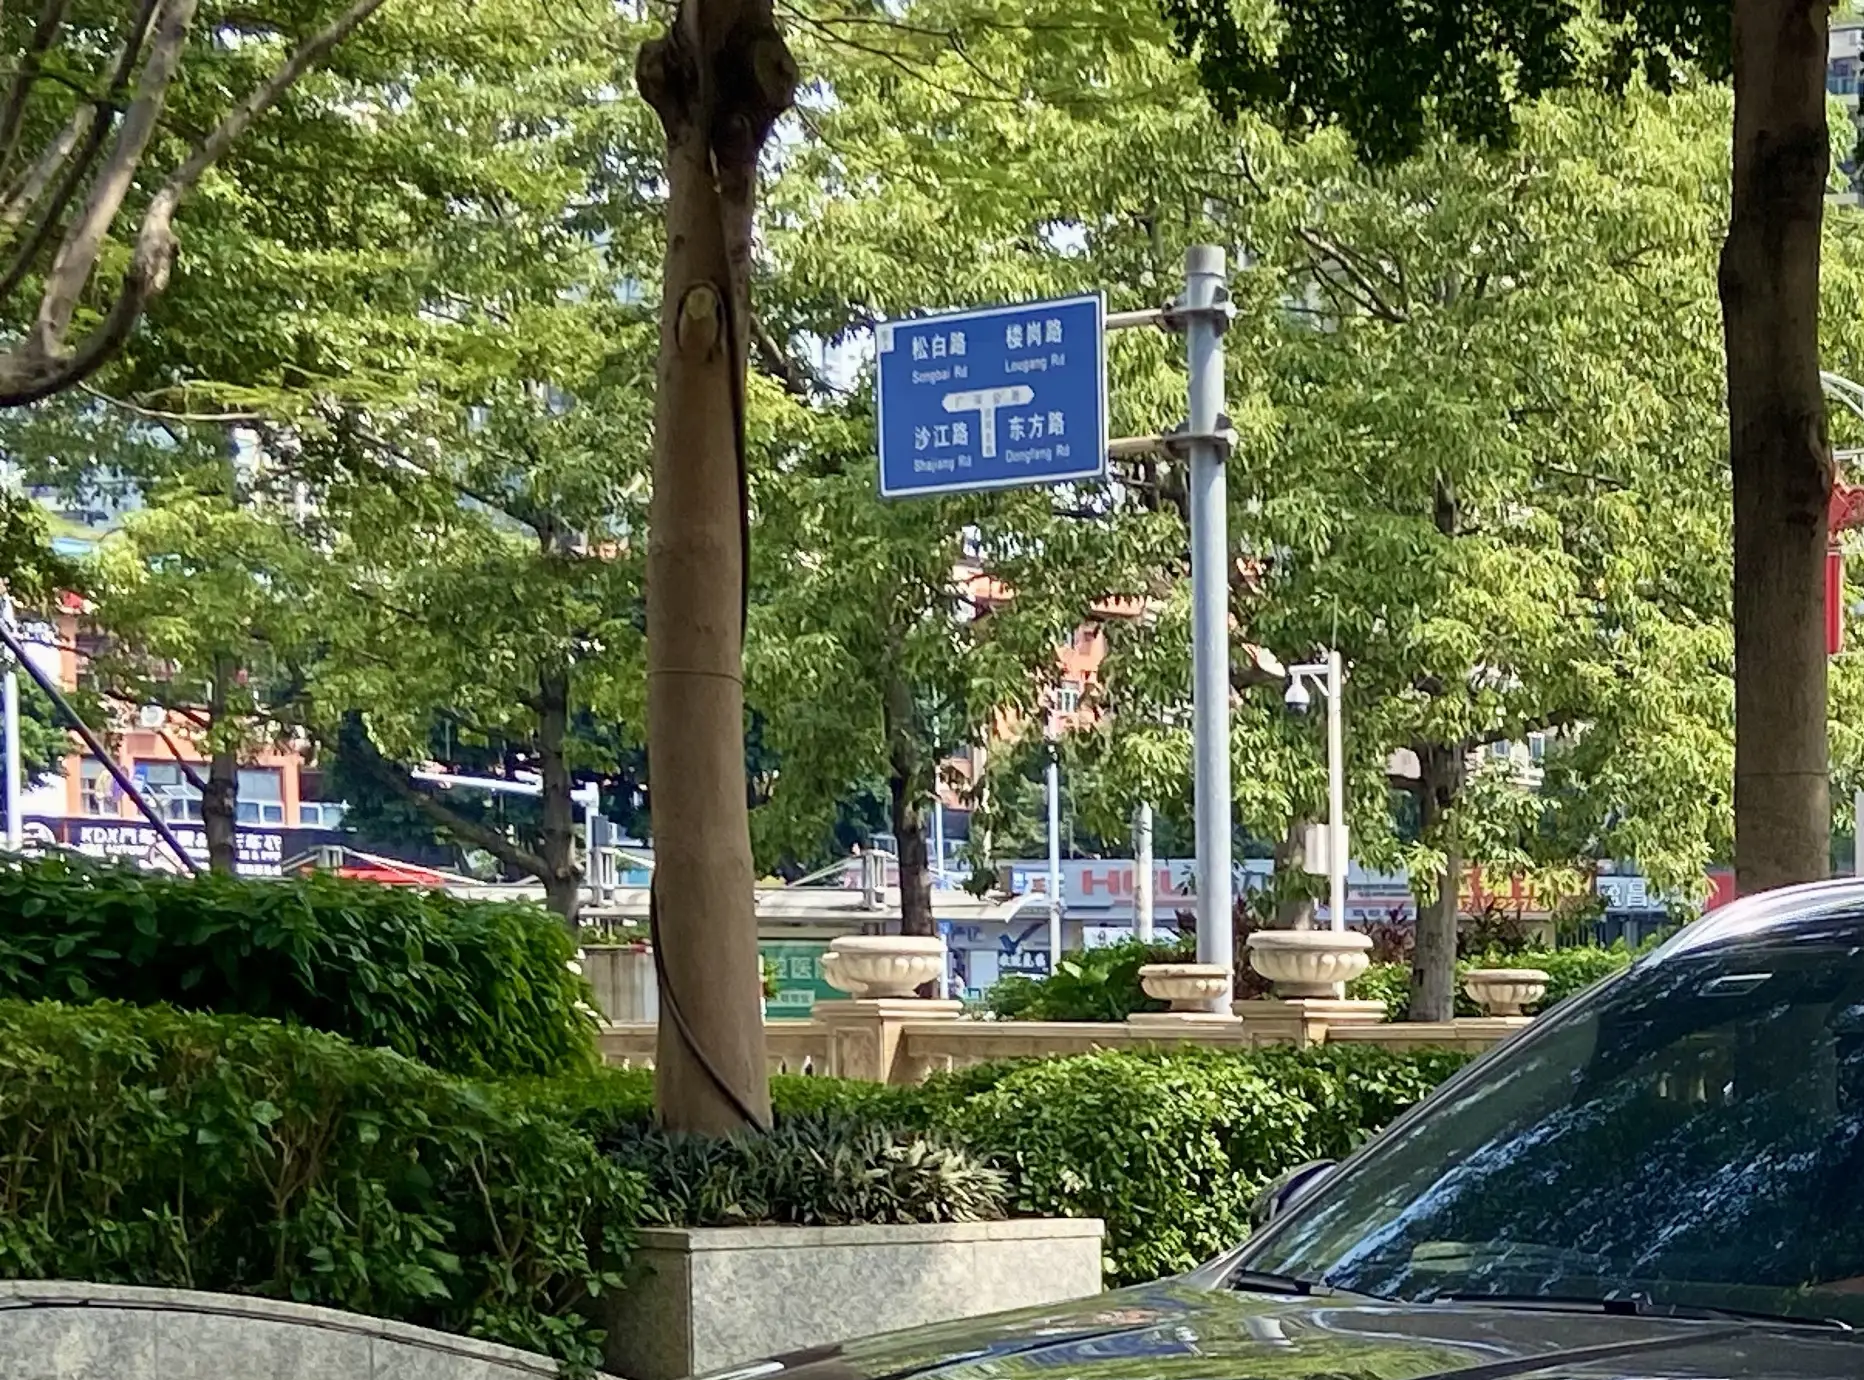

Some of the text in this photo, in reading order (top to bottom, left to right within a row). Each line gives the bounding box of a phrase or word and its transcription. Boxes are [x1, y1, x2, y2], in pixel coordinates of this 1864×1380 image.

[912, 331, 966, 361] 松白路
[1006, 318, 1063, 349] 楼岗路
[1051, 353, 1066, 367] Rd
[912, 364, 968, 385] Songbai Rd
[914, 421, 969, 450] 沙江路
[1008, 411, 1065, 441] 东方路
[958, 454, 972, 468] Rd
[1056, 443, 1070, 458] Rd
